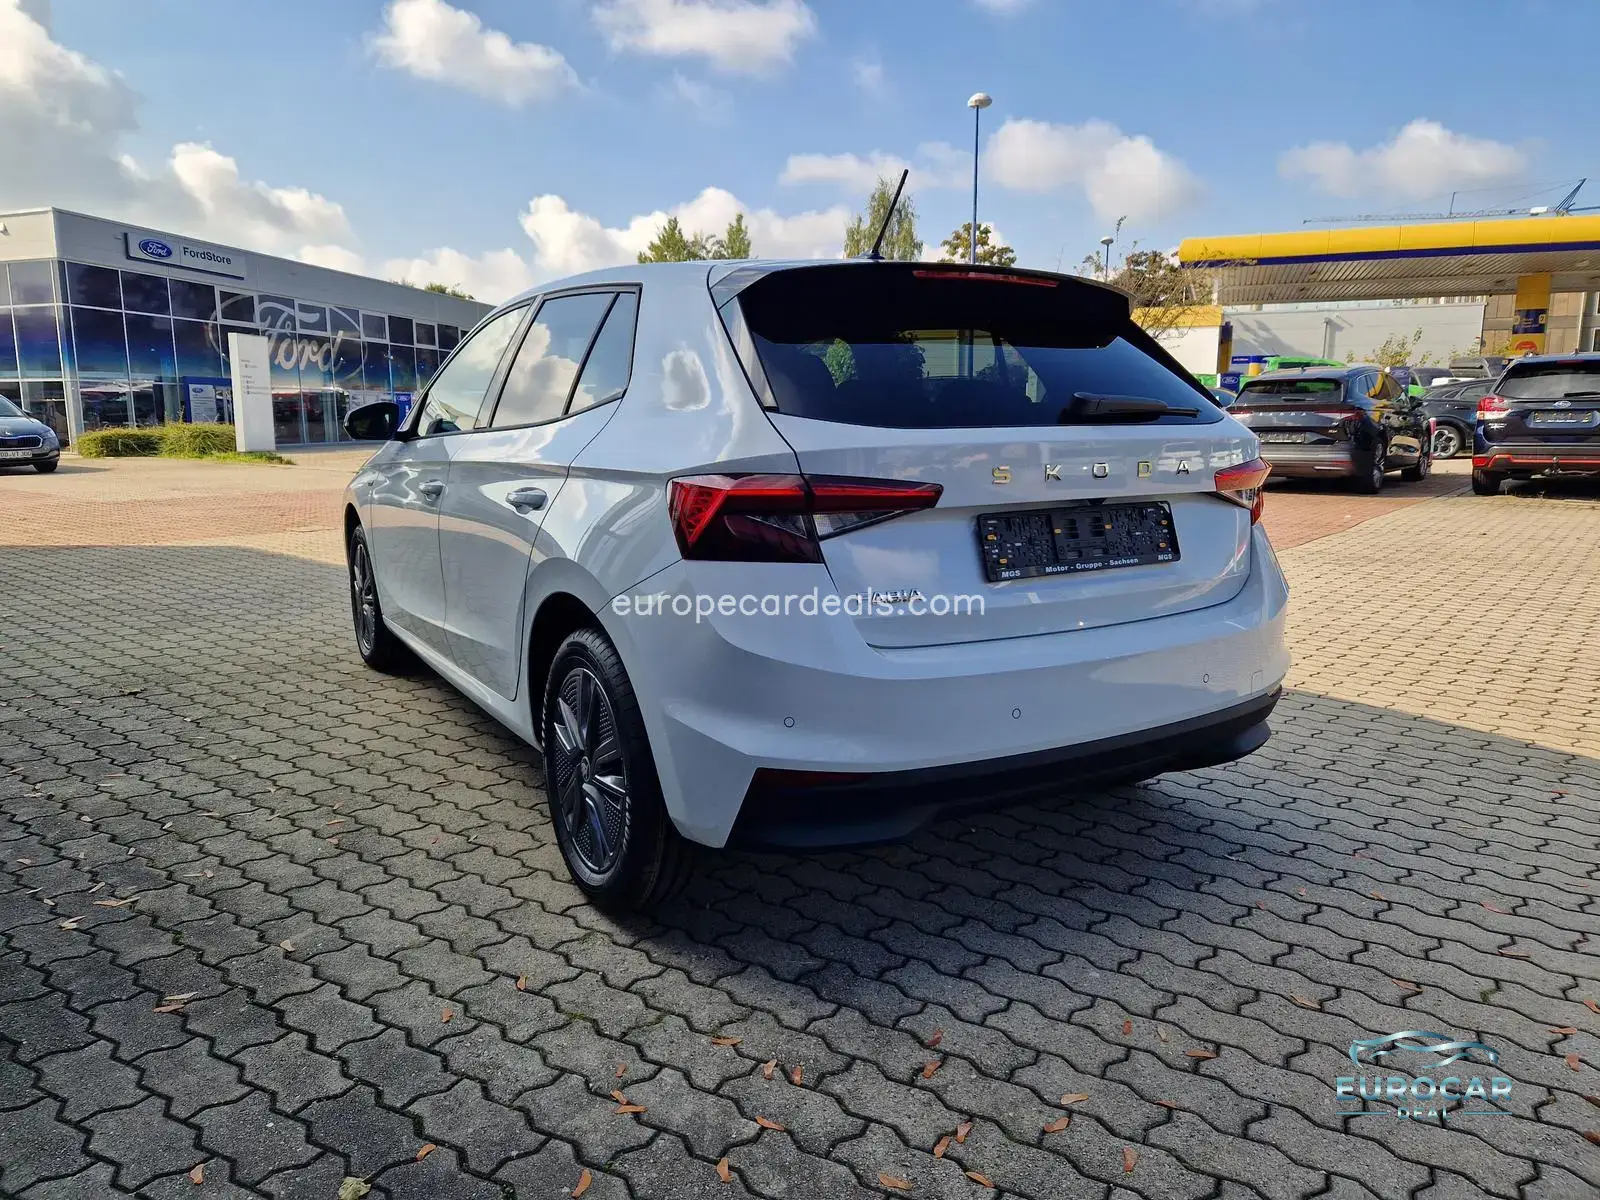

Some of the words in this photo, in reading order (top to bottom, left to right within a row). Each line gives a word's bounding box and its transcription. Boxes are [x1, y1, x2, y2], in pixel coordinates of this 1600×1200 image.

[183, 246, 232, 265] FordStore
[257, 301, 344, 372] Ford
[1045, 564, 1069, 573] Motor
[1076, 561, 1103, 571] Gruppe
[1109, 557, 1139, 566] Sachsen
[1158, 553, 1173, 561] MGS
[1001, 570, 1021, 578] MGS
